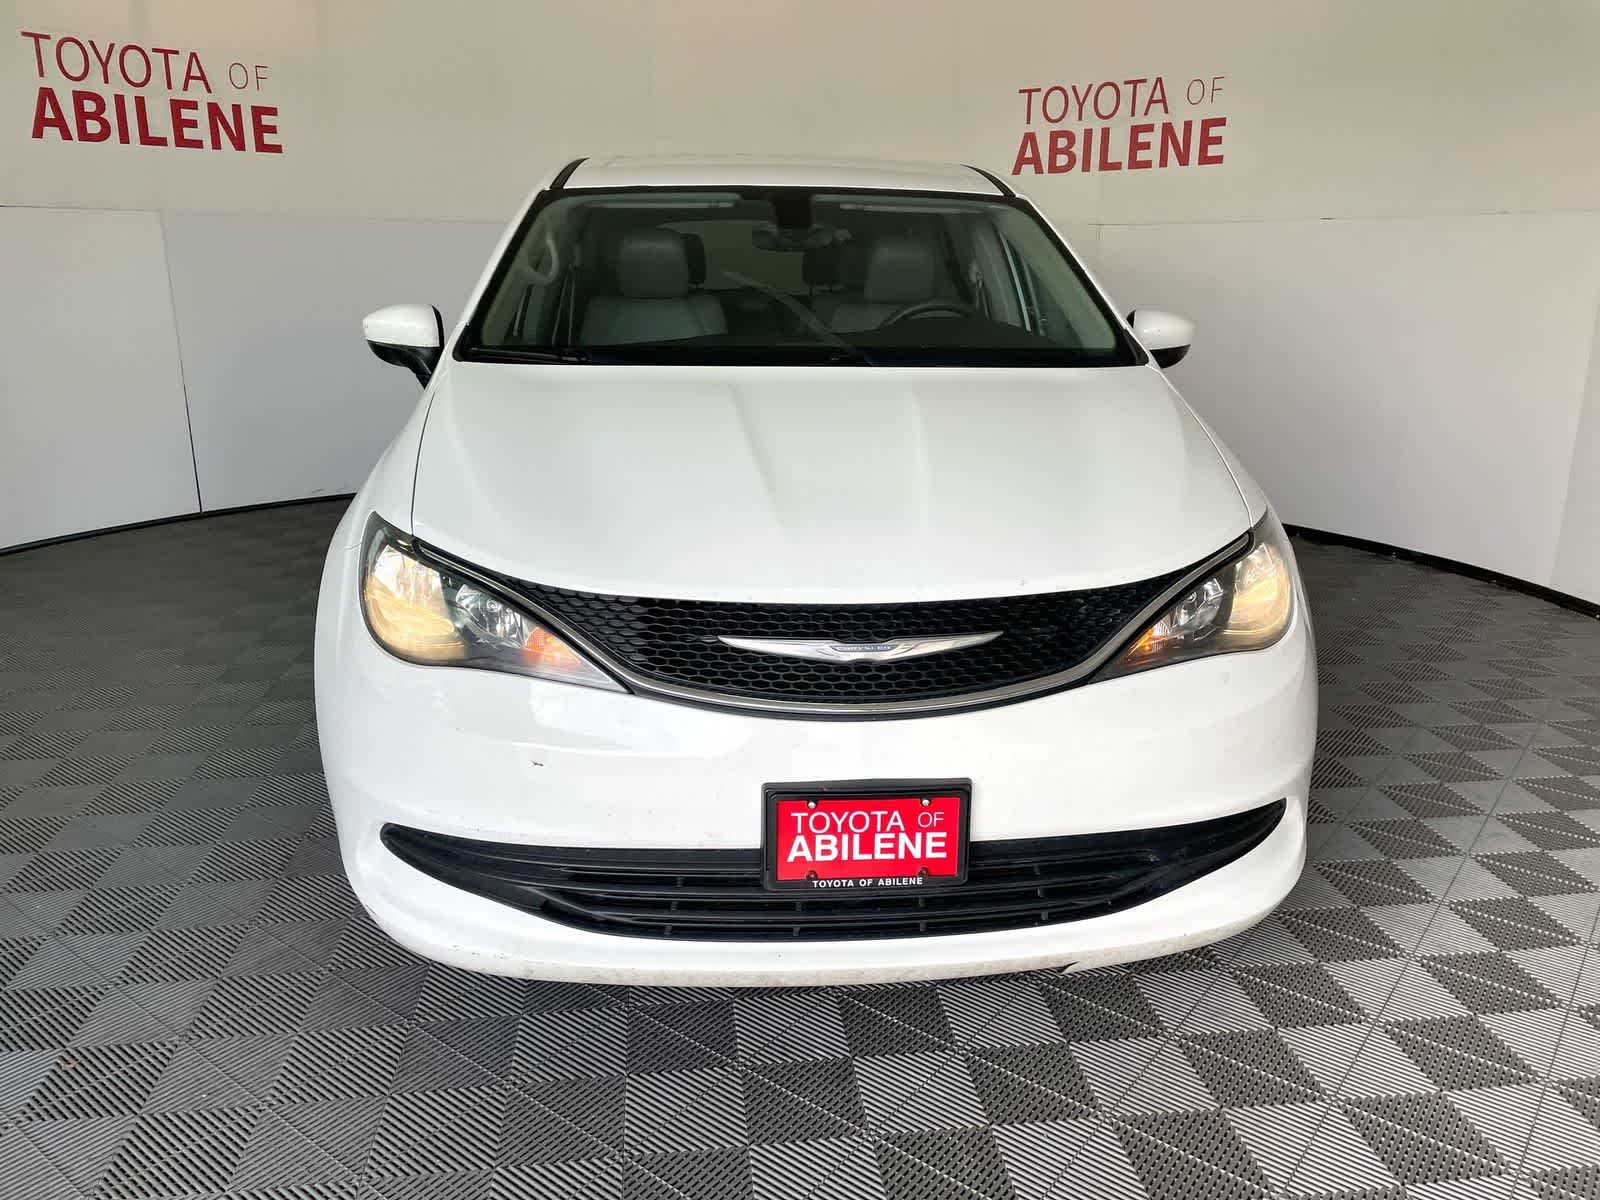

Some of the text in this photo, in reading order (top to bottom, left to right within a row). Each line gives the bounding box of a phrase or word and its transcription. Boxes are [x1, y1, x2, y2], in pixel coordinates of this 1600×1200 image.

[20, 31, 268, 94] TOYOTA OF
[31, 86, 283, 154] ABILENE
[1018, 76, 1225, 125] TOYOTA OF
[1011, 117, 1227, 175] ABILENE
[787, 832, 947, 862] ABILENE
[791, 811, 944, 834] TOYOTA OF
[812, 877, 923, 888] TOYOTA OF ABILENE
